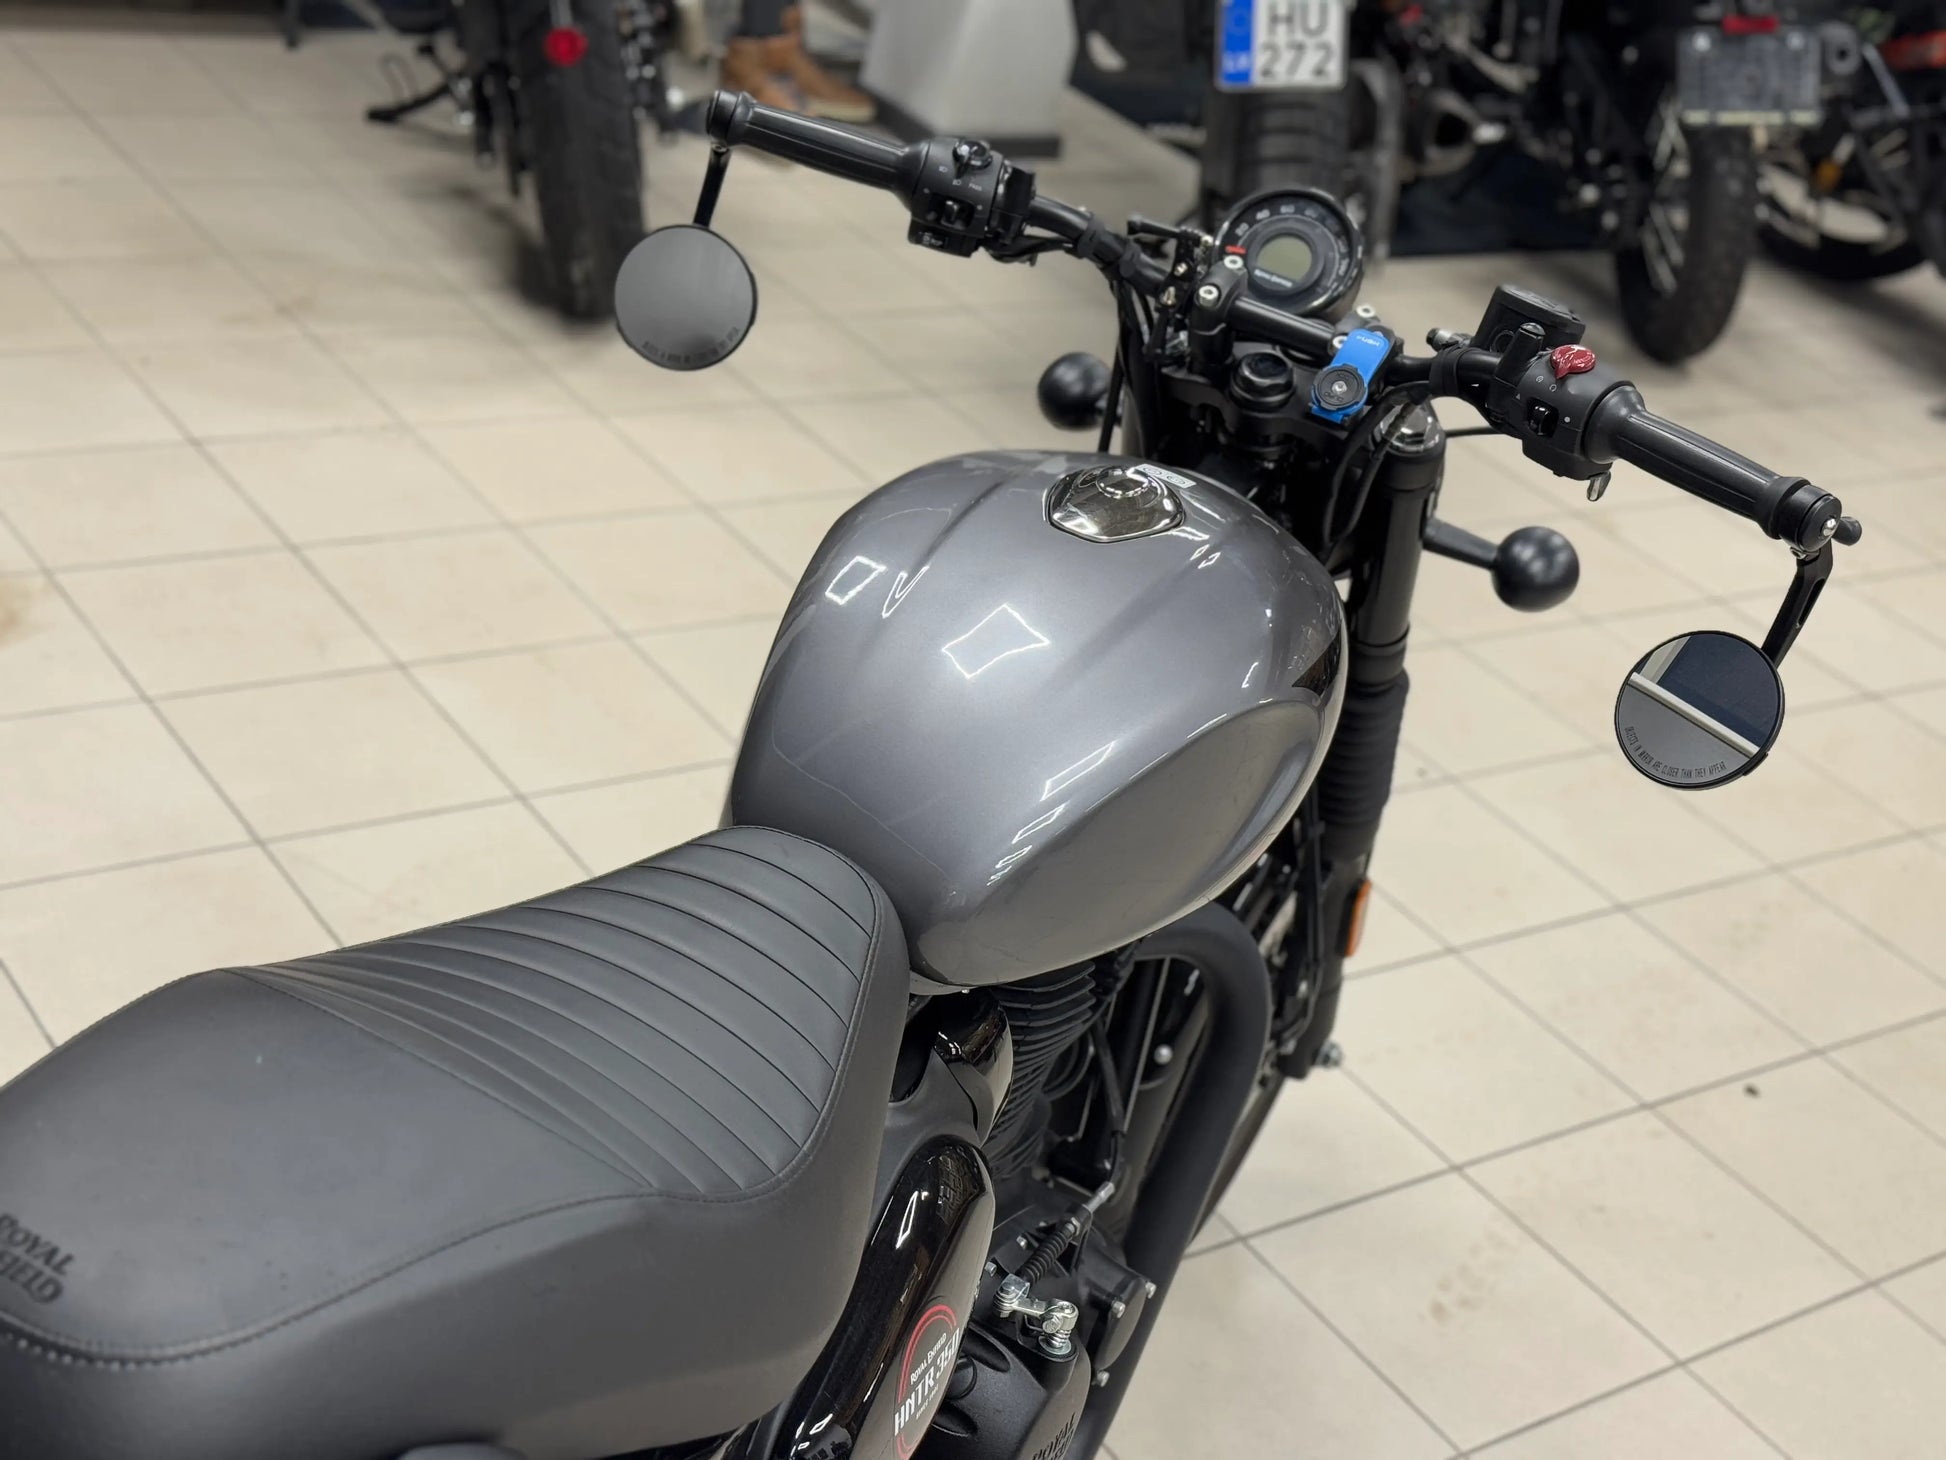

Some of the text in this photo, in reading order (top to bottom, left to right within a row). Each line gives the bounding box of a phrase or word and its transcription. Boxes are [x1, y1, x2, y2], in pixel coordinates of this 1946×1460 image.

[1260, 41, 1333, 77] 272
[1652, 760, 1663, 772] ARE
[1661, 765, 1680, 777] CLOSER
[1681, 768, 1693, 779] THAN
[1695, 768, 1707, 778] THEY
[894, 1327, 960, 1437] HNTR 350
[910, 1360, 928, 1386] ROYAL
